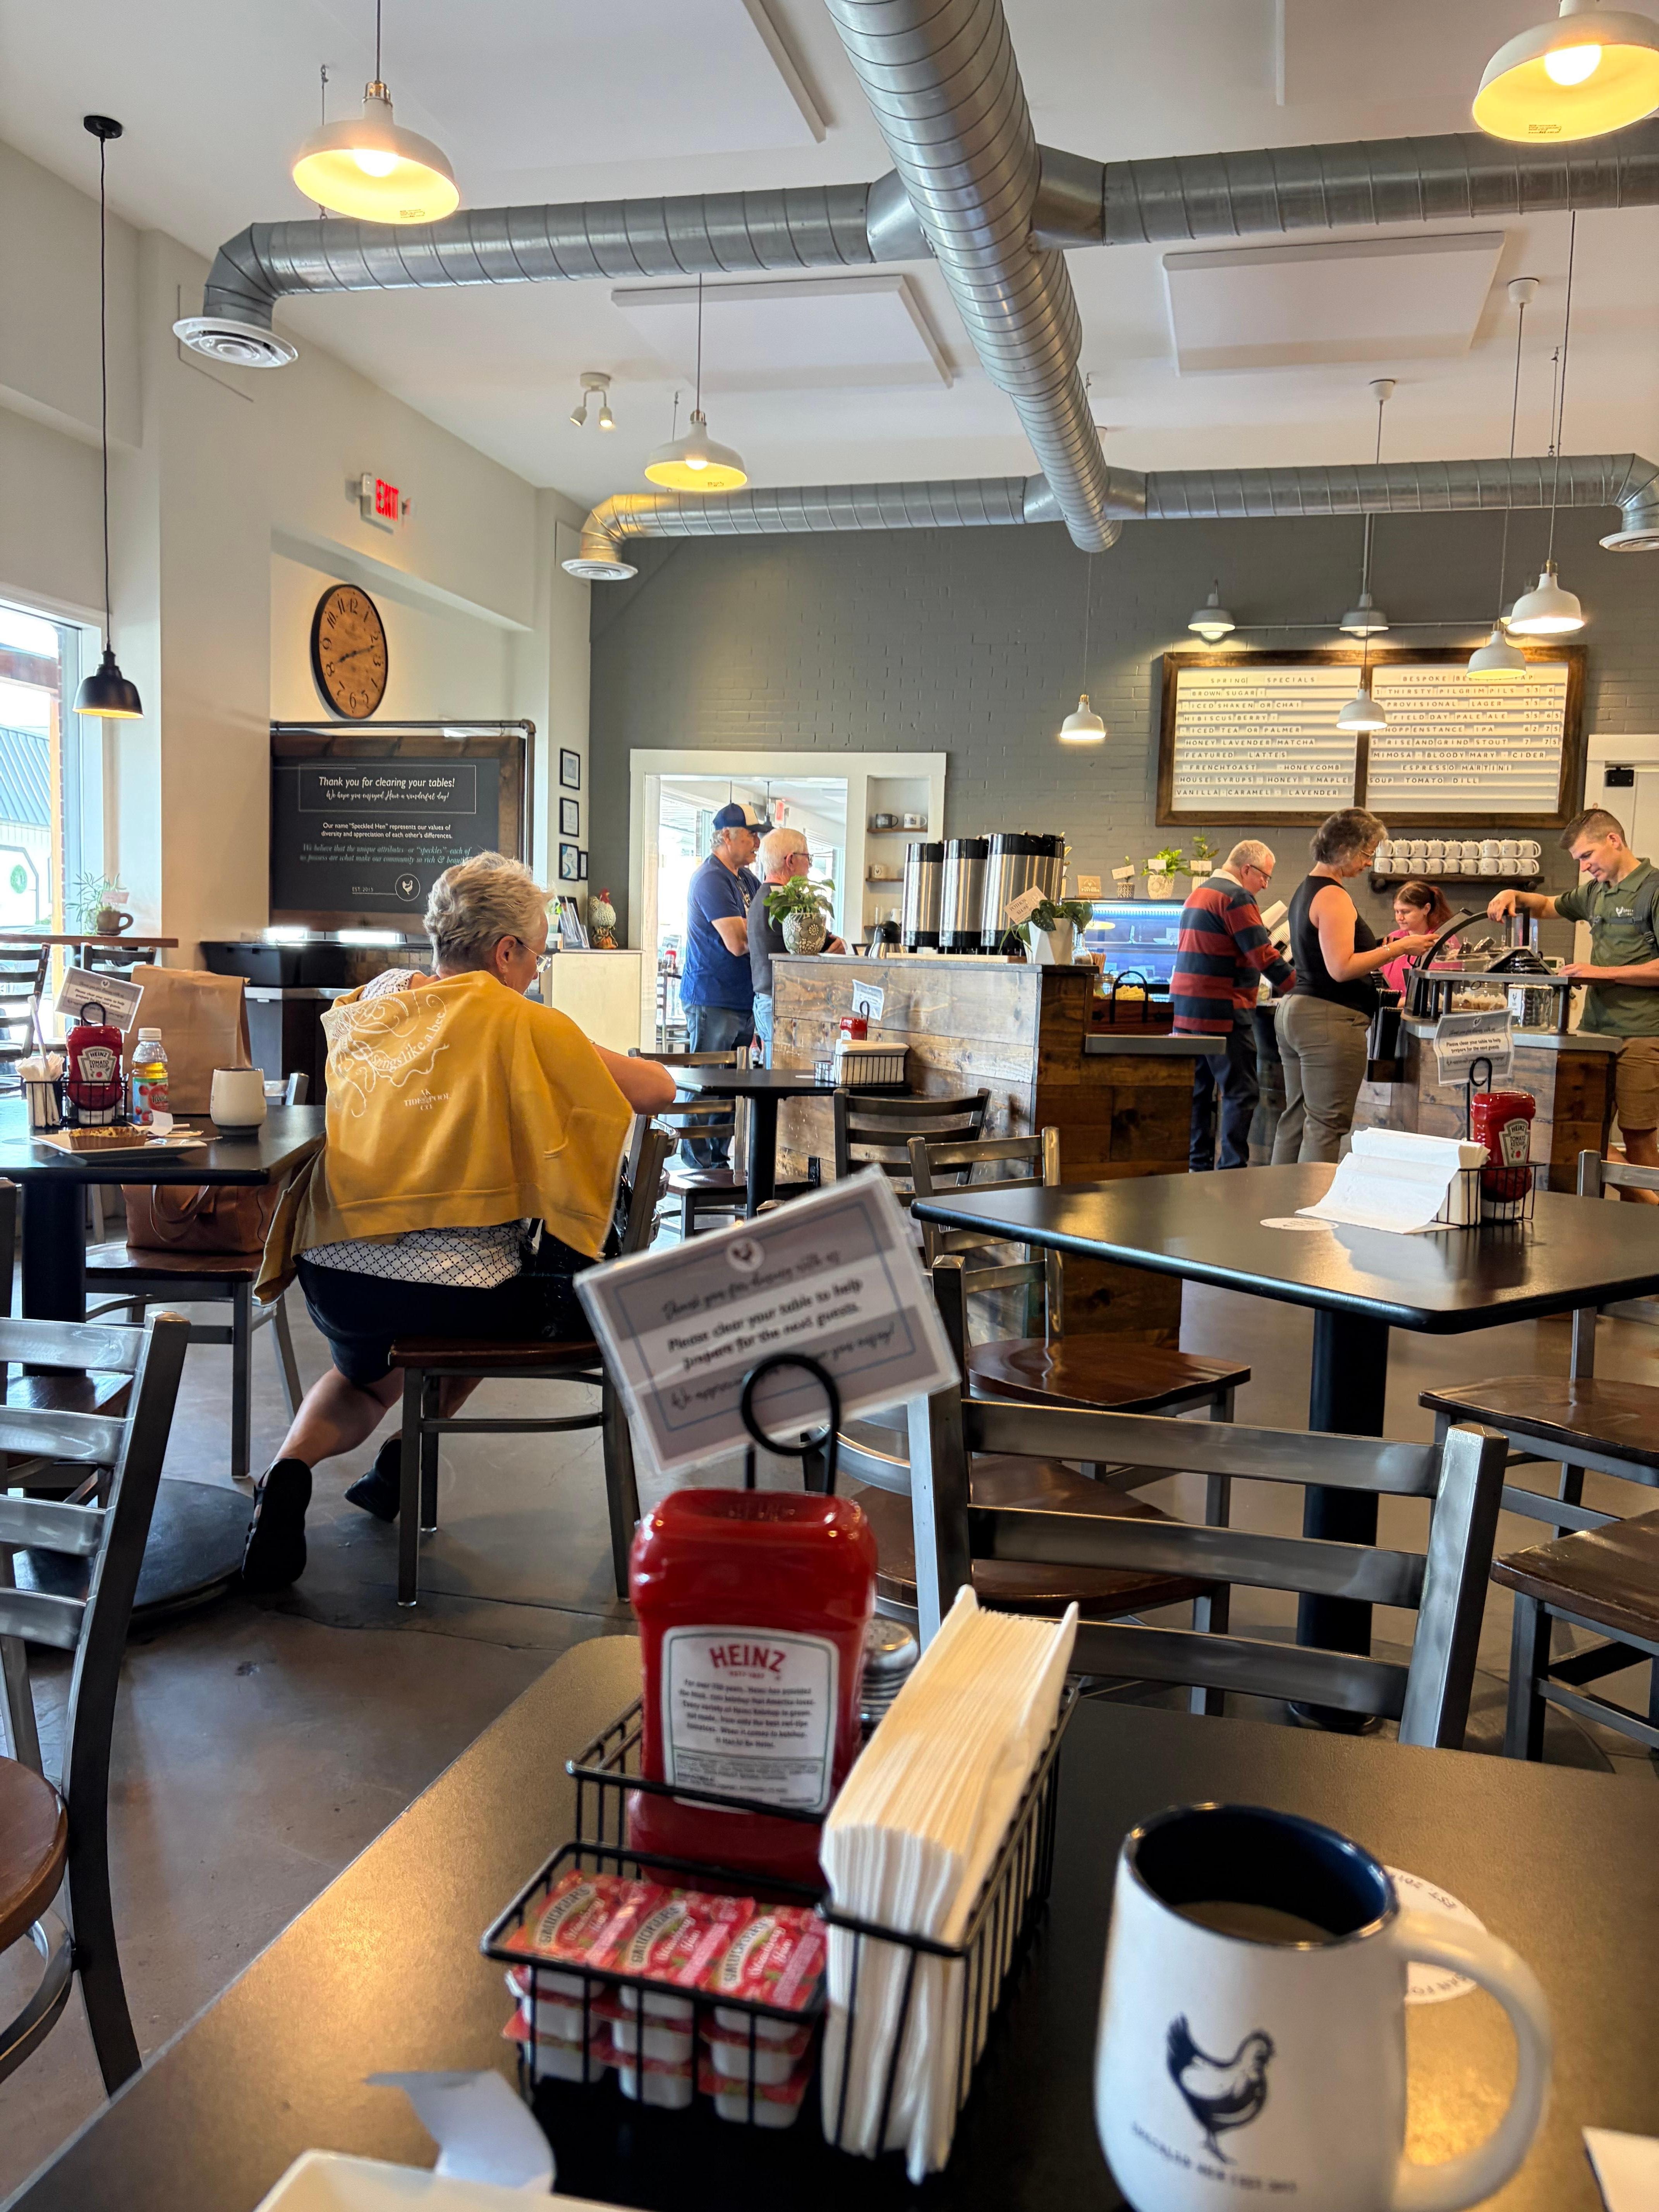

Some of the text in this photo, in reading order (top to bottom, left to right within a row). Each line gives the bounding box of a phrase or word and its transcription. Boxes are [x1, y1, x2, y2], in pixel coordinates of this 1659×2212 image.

[319, 776, 455, 789] Thank you for clearing your tables!
[400, 1041, 426, 1063] like
[709, 1644, 787, 1673] HEINZ
